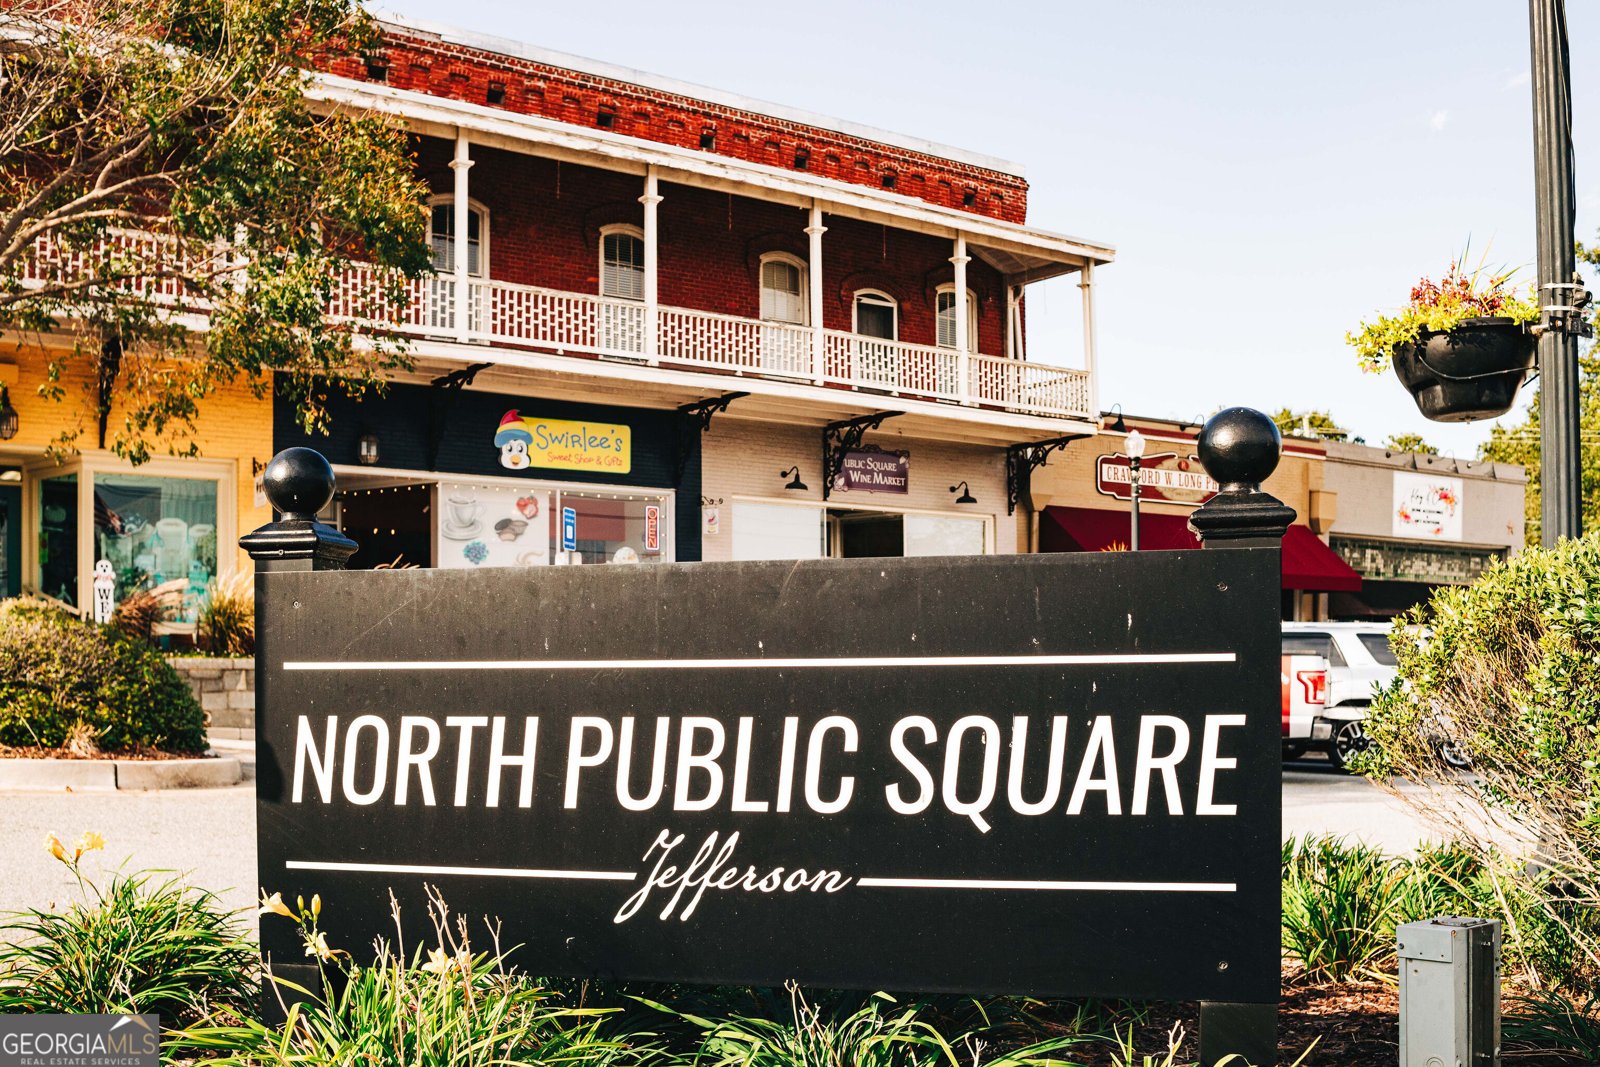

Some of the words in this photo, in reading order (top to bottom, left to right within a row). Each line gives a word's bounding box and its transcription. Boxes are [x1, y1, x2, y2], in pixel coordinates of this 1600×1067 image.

[844, 458, 865, 469] UBLIC
[866, 457, 897, 471] SQUARE
[849, 470, 872, 484] WINE
[873, 472, 905, 486] MARKET
[1106, 466, 1161, 485] CRAWORD
[1178, 473, 1202, 489] LONG
[648, 508, 657, 548] OPEN
[292, 715, 539, 808] NORTH
[564, 716, 858, 813] PUBLIC
[886, 715, 1246, 833] SQUARE
[613, 829, 852, 924] Jefferson
